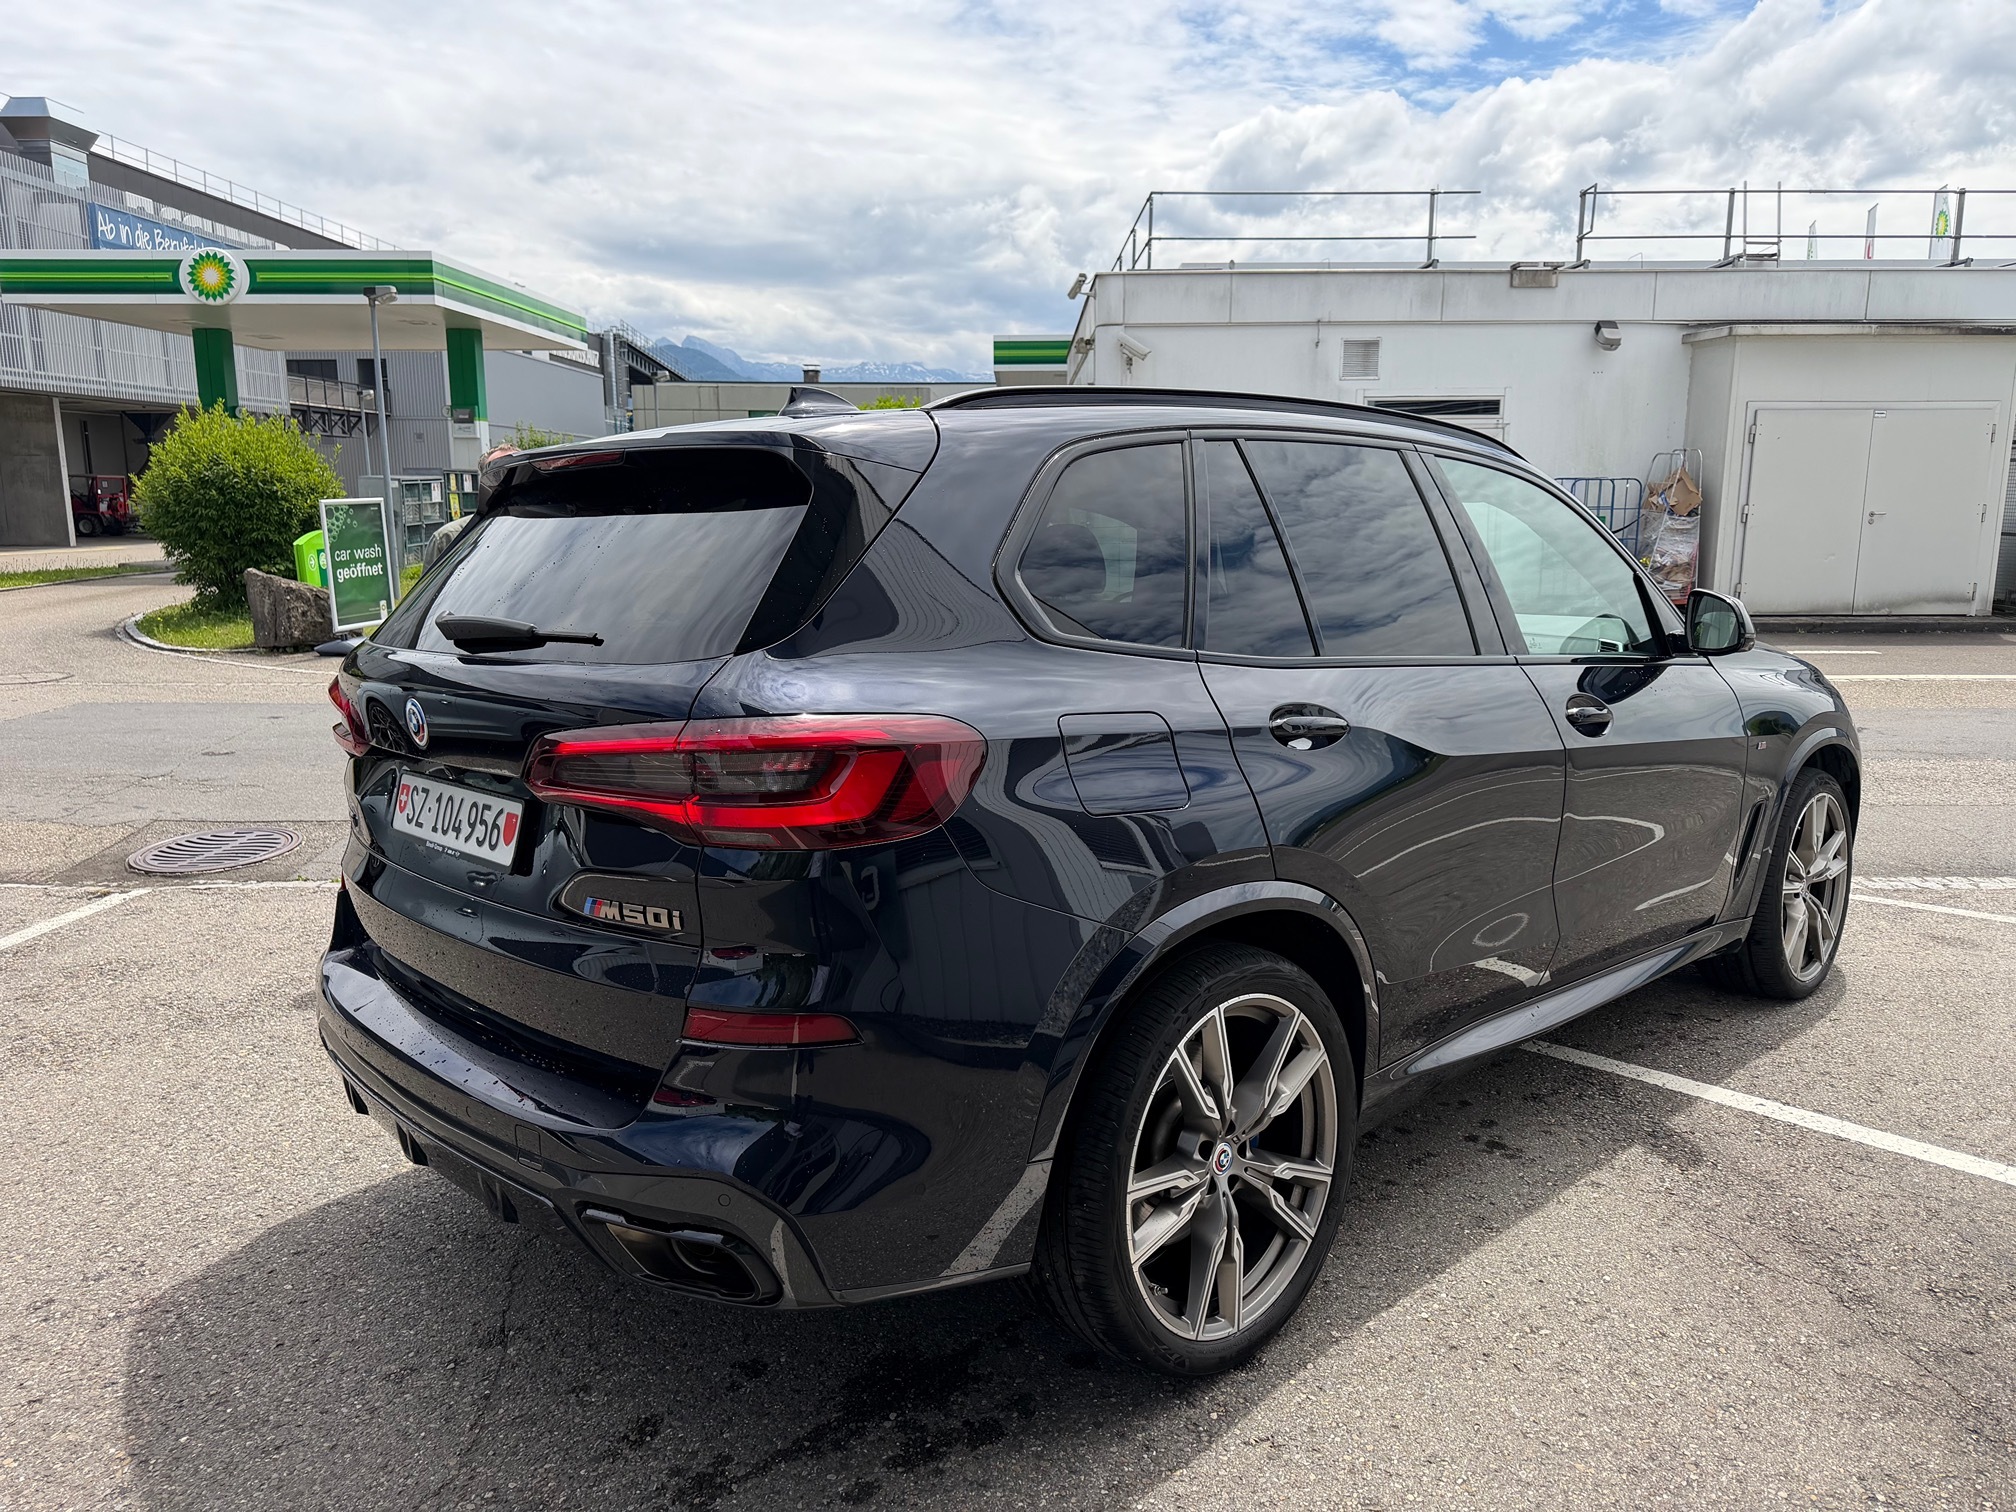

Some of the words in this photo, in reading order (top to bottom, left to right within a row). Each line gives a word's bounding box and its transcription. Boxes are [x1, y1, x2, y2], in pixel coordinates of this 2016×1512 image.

[98, 211, 116, 240] Ab
[118, 217, 133, 246] in
[135, 223, 152, 250] die
[334, 548, 351, 562] car
[354, 544, 382, 560] wash
[336, 562, 383, 583] geöffnet
[599, 900, 682, 931] M50i
